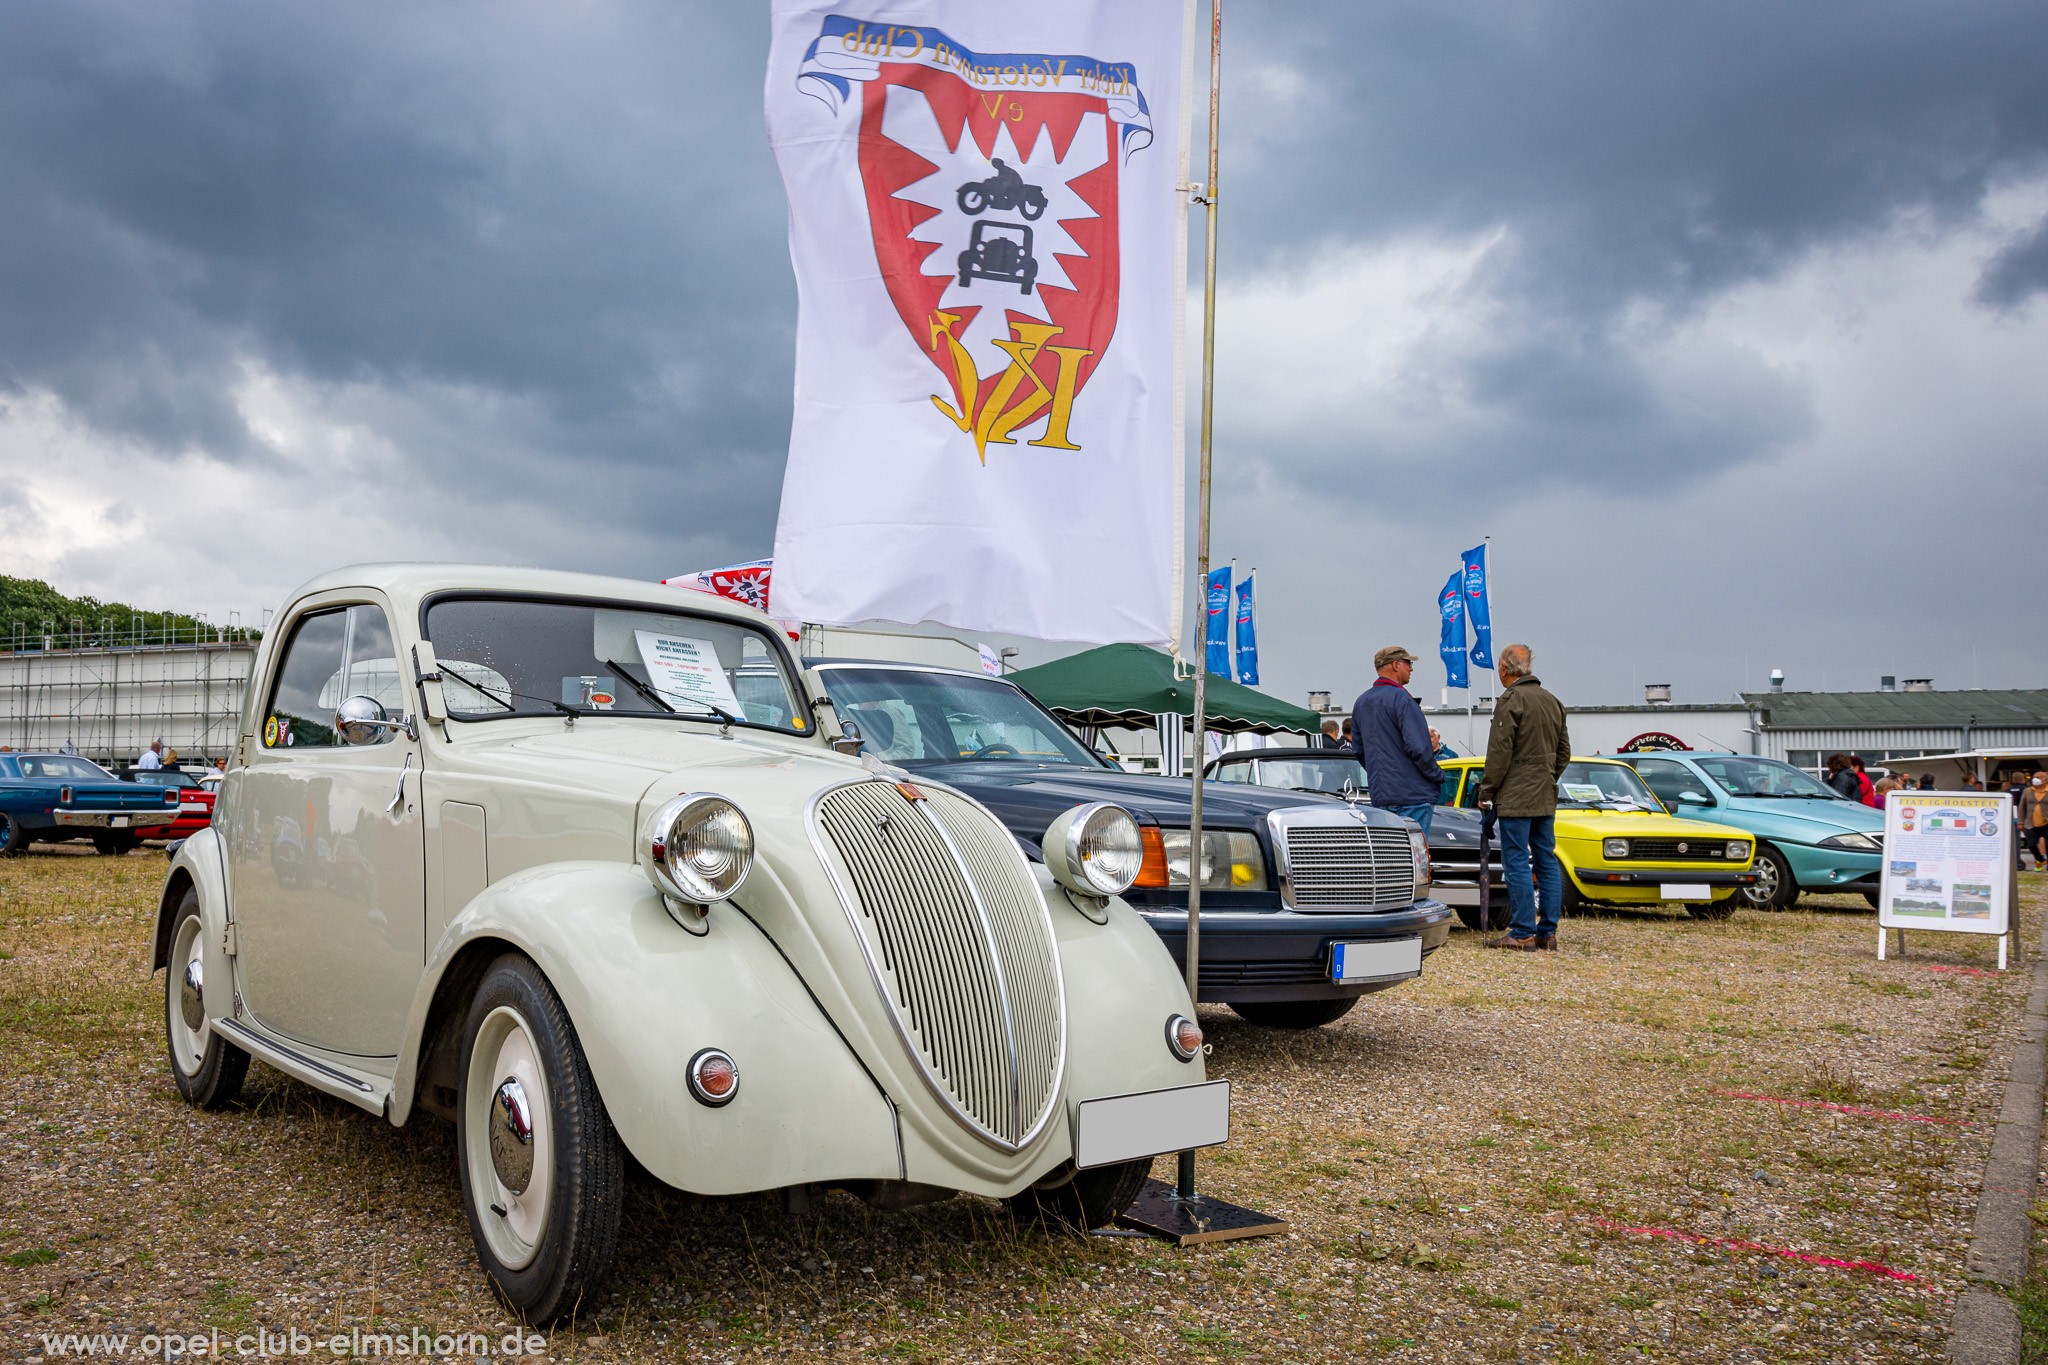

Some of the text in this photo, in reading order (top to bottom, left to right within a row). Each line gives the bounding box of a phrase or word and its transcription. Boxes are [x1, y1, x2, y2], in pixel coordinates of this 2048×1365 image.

[1659, 736, 1684, 751] Café
[1899, 798, 1923, 806] FIAT
[1336, 964, 1341, 972] D
